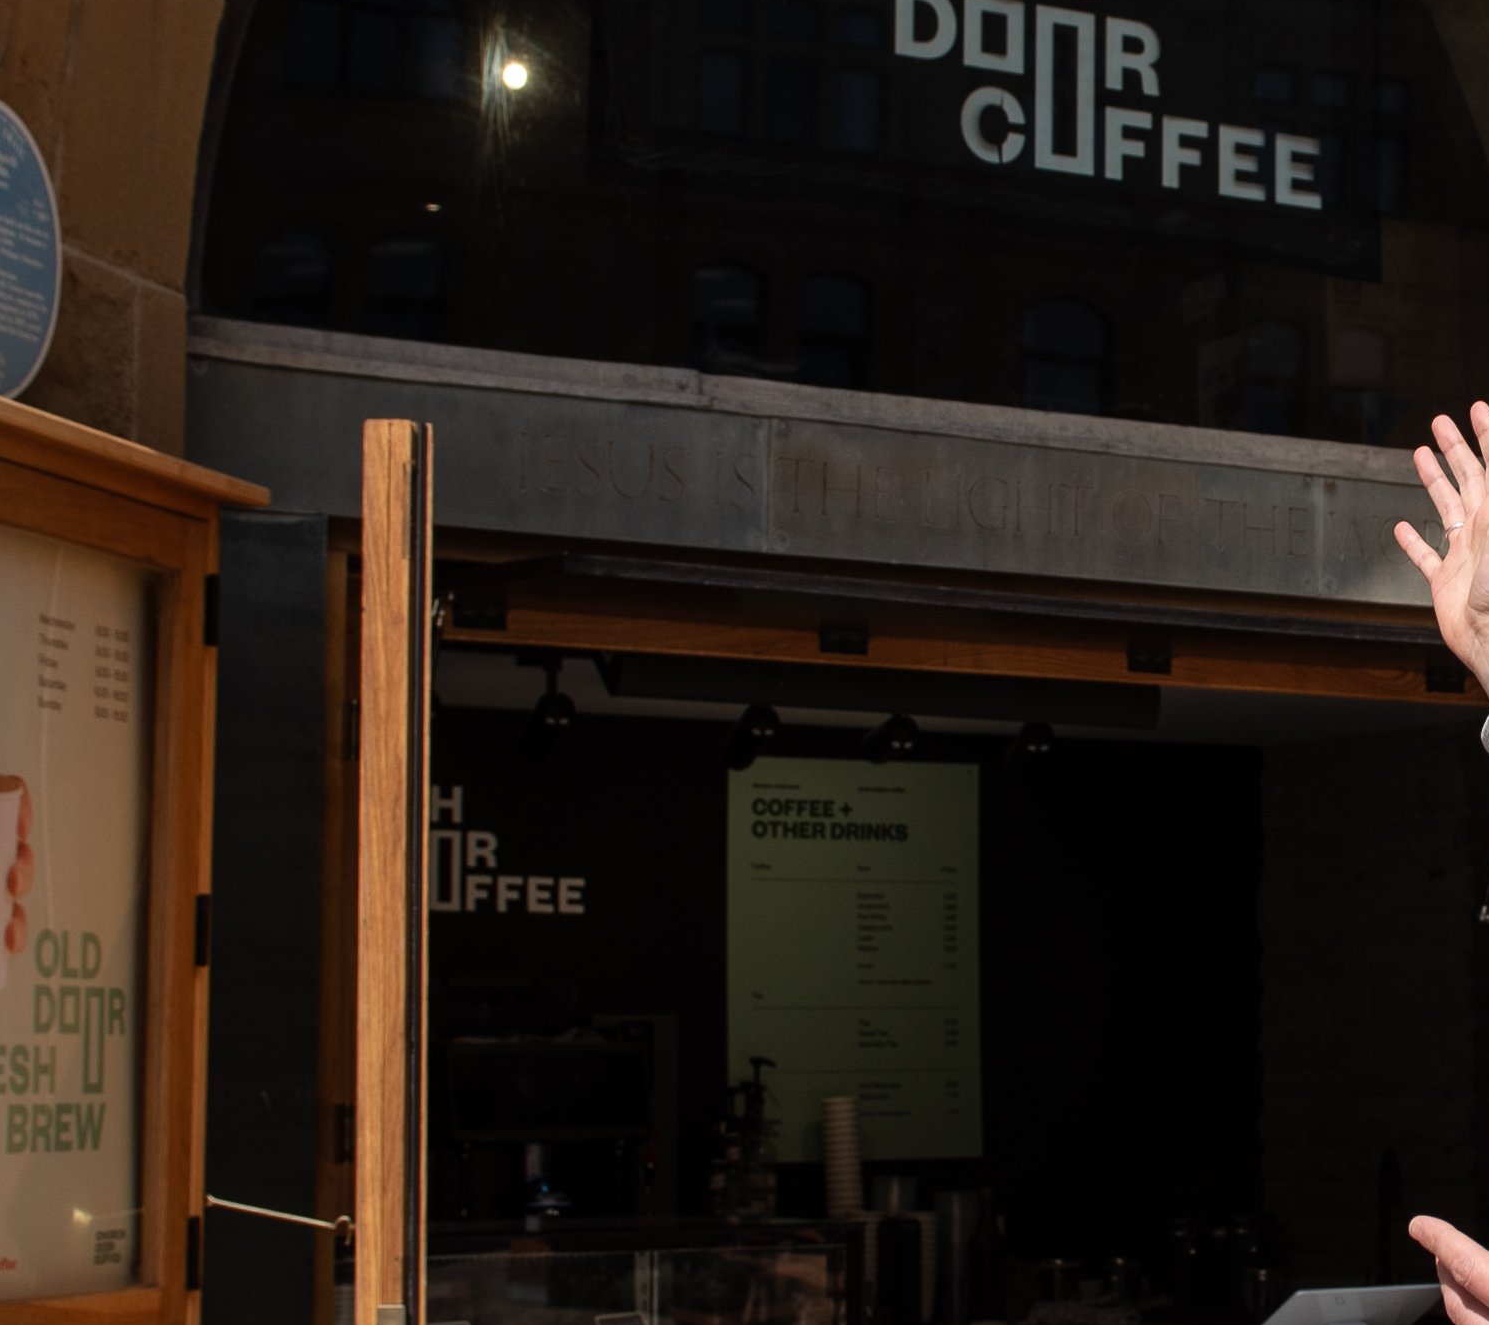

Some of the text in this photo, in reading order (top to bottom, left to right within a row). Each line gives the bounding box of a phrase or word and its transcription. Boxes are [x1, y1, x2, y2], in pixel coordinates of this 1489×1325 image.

[961, 85, 1322, 209] COFFEE
[752, 797, 835, 817] COFFEE
[752, 820, 908, 842] OTHER DRINKS
[34, 928, 101, 979] OLD
[6, 1102, 106, 1155] BREW
